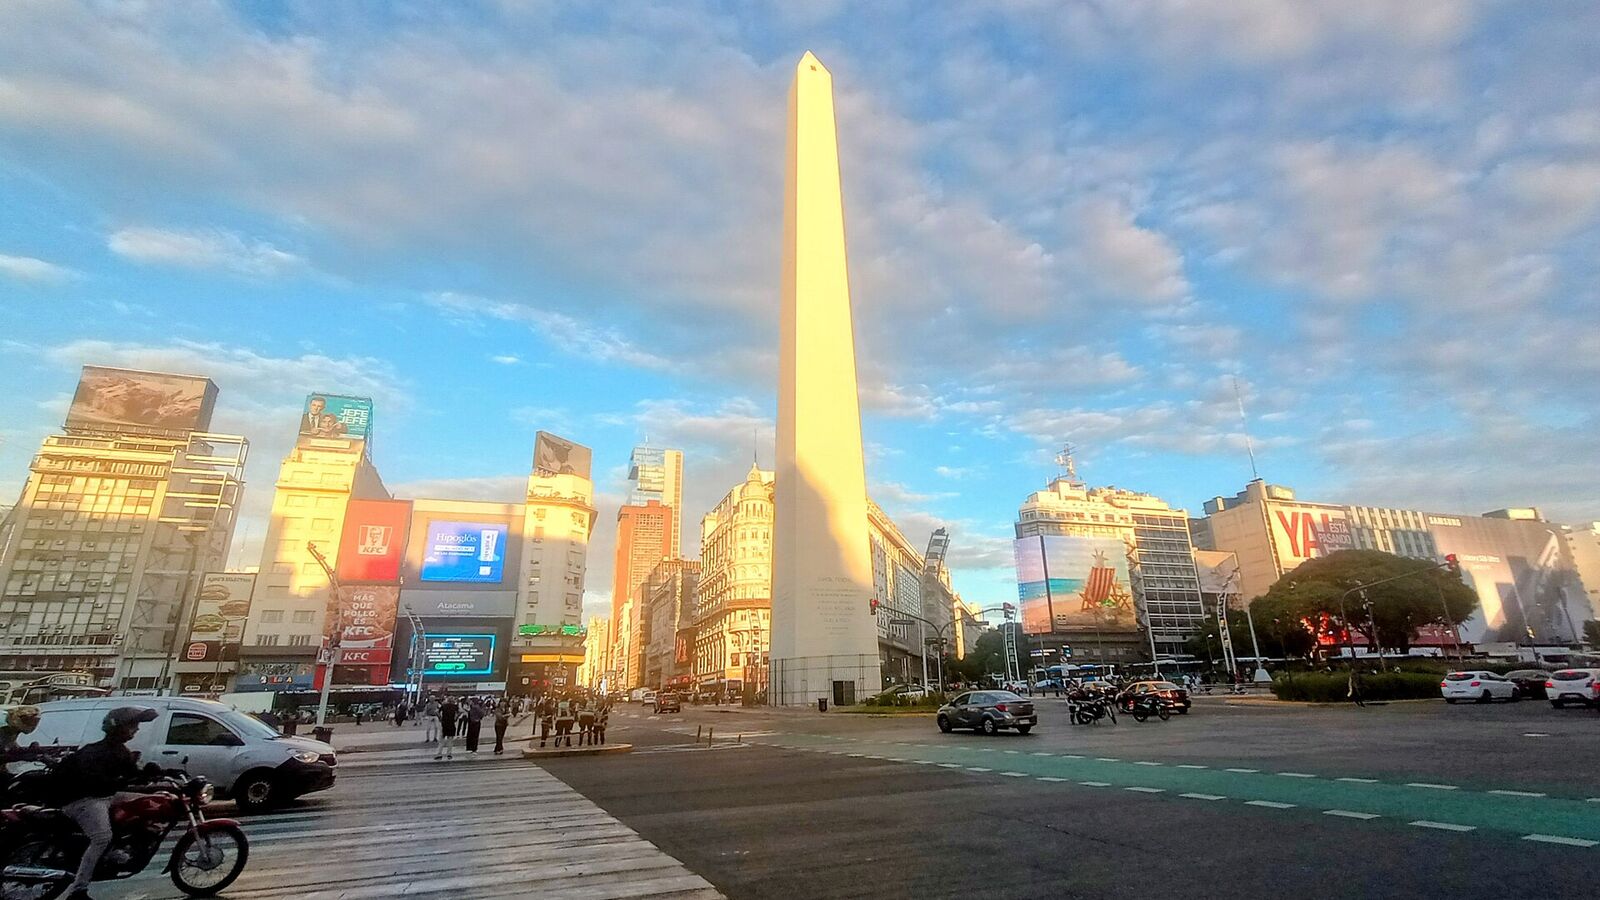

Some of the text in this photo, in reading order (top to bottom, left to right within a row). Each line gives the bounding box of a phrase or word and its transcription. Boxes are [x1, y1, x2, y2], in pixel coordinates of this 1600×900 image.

[340, 408, 369, 418] JEFE
[338, 416, 367, 425] JEFE
[1428, 516, 1462, 526] SAMSUNG
[1329, 521, 1349, 533] ESTÁ
[436, 533, 478, 544] Hipoglós
[1318, 533, 1352, 545] PASANDO
[353, 593, 375, 602] MÁS
[352, 602, 373, 610] QUE
[344, 626, 375, 636] KFC
[343, 652, 370, 661] KFC
